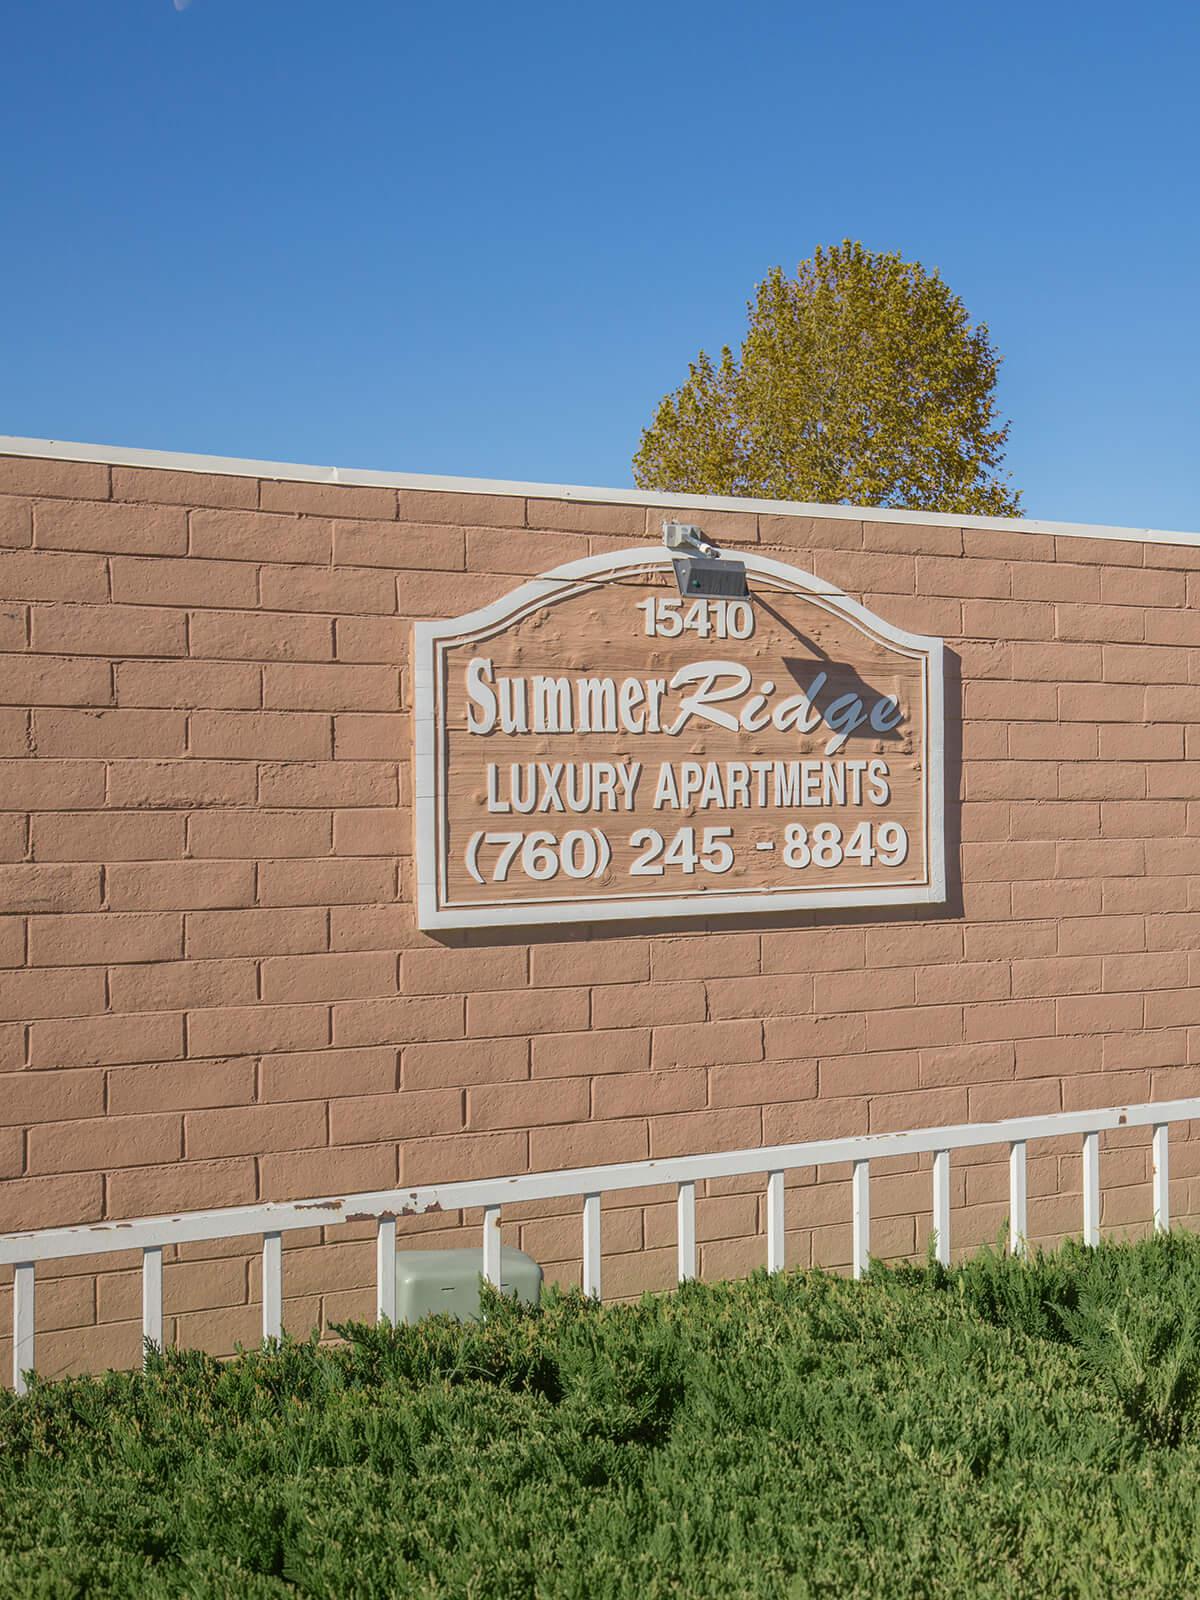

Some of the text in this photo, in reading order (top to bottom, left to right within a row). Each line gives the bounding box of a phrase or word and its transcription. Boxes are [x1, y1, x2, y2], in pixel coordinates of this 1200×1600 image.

[636, 597, 754, 640] 15410
[487, 759, 890, 814] LUXURY APARTMENTS
[464, 827, 612, 885] (760)
[629, 826, 735, 877] 245
